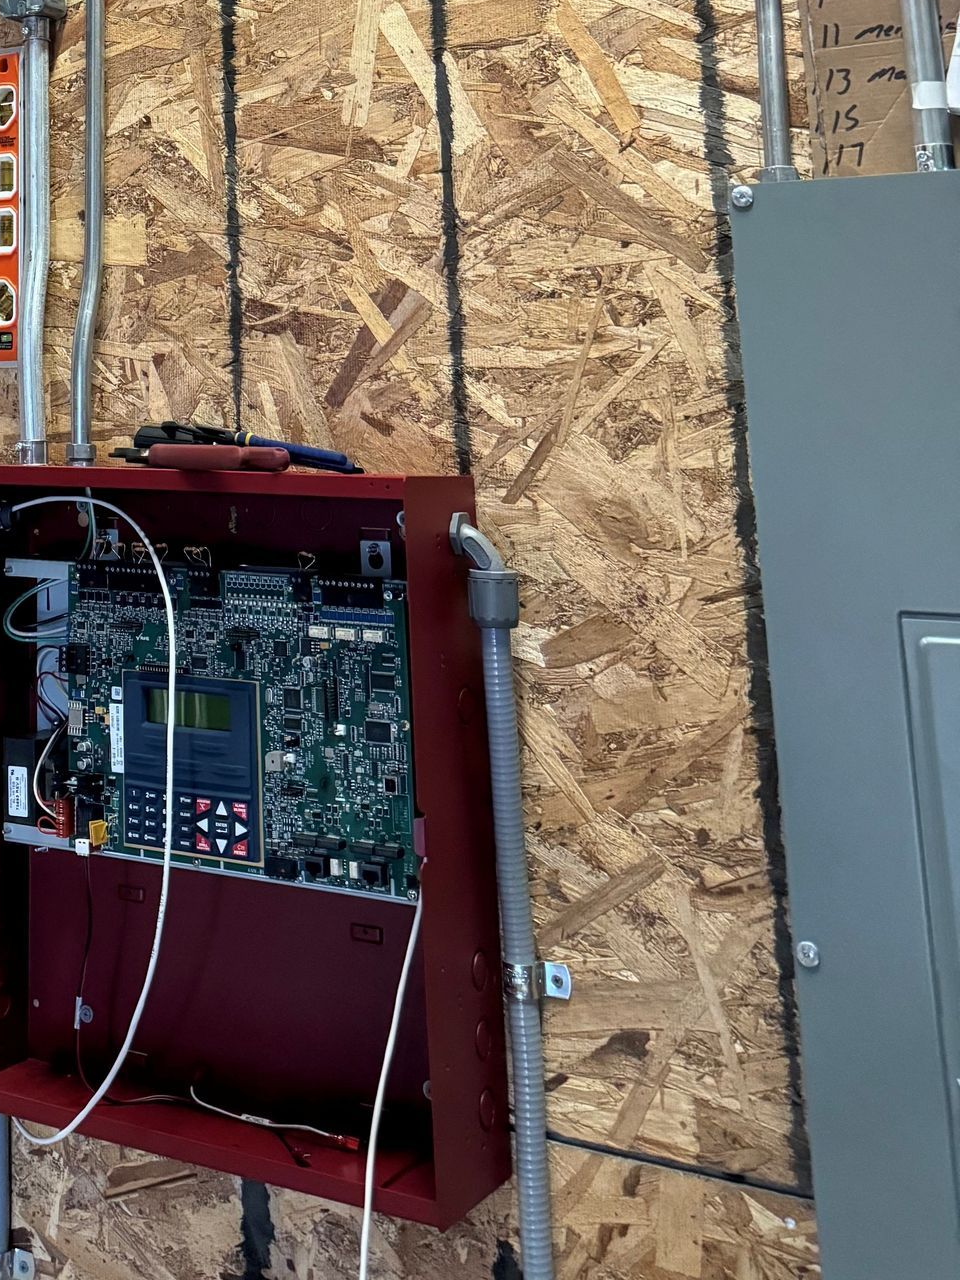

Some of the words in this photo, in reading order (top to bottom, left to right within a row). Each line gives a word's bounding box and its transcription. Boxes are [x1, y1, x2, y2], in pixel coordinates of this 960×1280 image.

[823, 23, 839, 48] 11
[826, 69, 851, 94] 13
[832, 105, 859, 134] 15
[837, 142, 864, 167] 17
